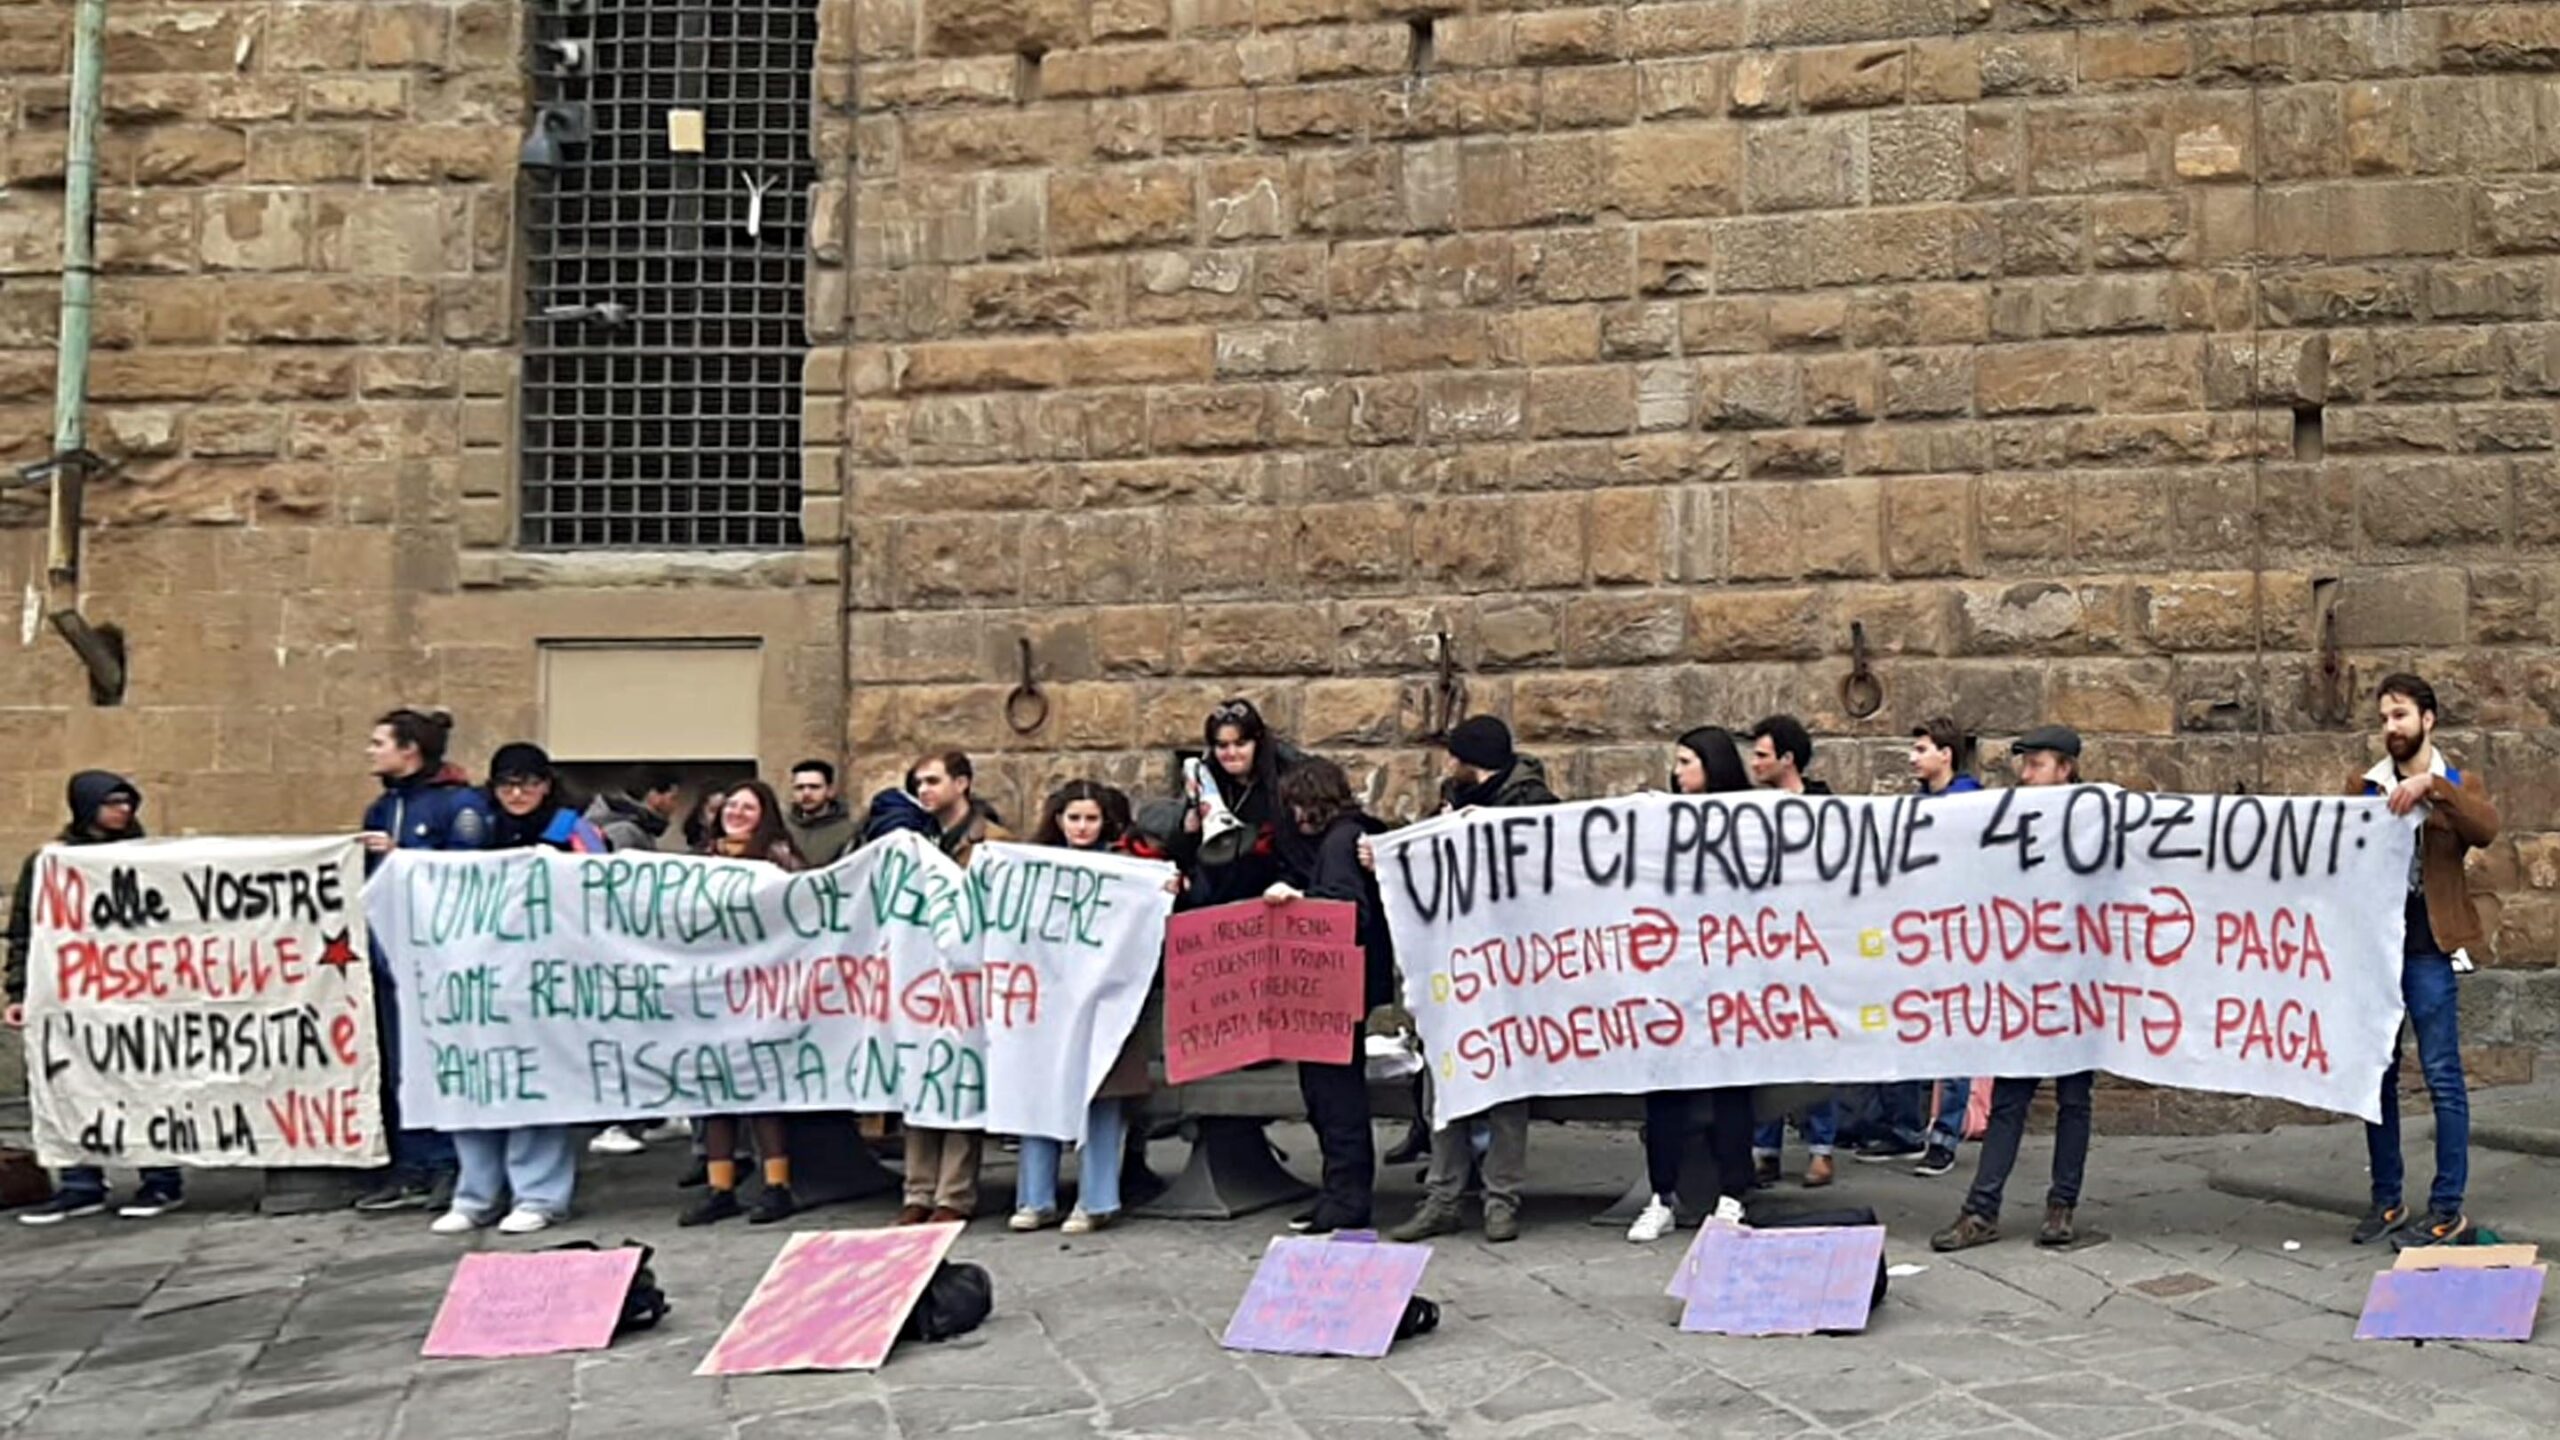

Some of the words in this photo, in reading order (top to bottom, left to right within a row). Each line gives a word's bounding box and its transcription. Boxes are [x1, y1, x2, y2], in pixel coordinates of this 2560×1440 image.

[1398, 813, 1554, 923] UNIFI
[1580, 806, 1637, 890] CI
[1663, 796, 1939, 896] PROPONE
[2062, 785, 2373, 881] OPZIONI:
[37, 855, 86, 931] NO
[91, 866, 170, 929] alle
[183, 863, 344, 923] VOSTRE
[580, 858, 767, 945] PROPOSTA
[783, 863, 853, 938] CHE
[57, 935, 305, 1001] PASSERELLE
[1699, 907, 1830, 967] PAGA
[2216, 907, 2331, 981] PAGA
[529, 960, 674, 1024] RENDERE
[1707, 983, 1839, 1047] PAGA
[2214, 997, 2329, 1075] PAGA
[80, 1101, 125, 1155] di
[148, 1102, 199, 1152] chi
[214, 1102, 258, 1154] LA
[267, 1088, 362, 1149] VIVE
